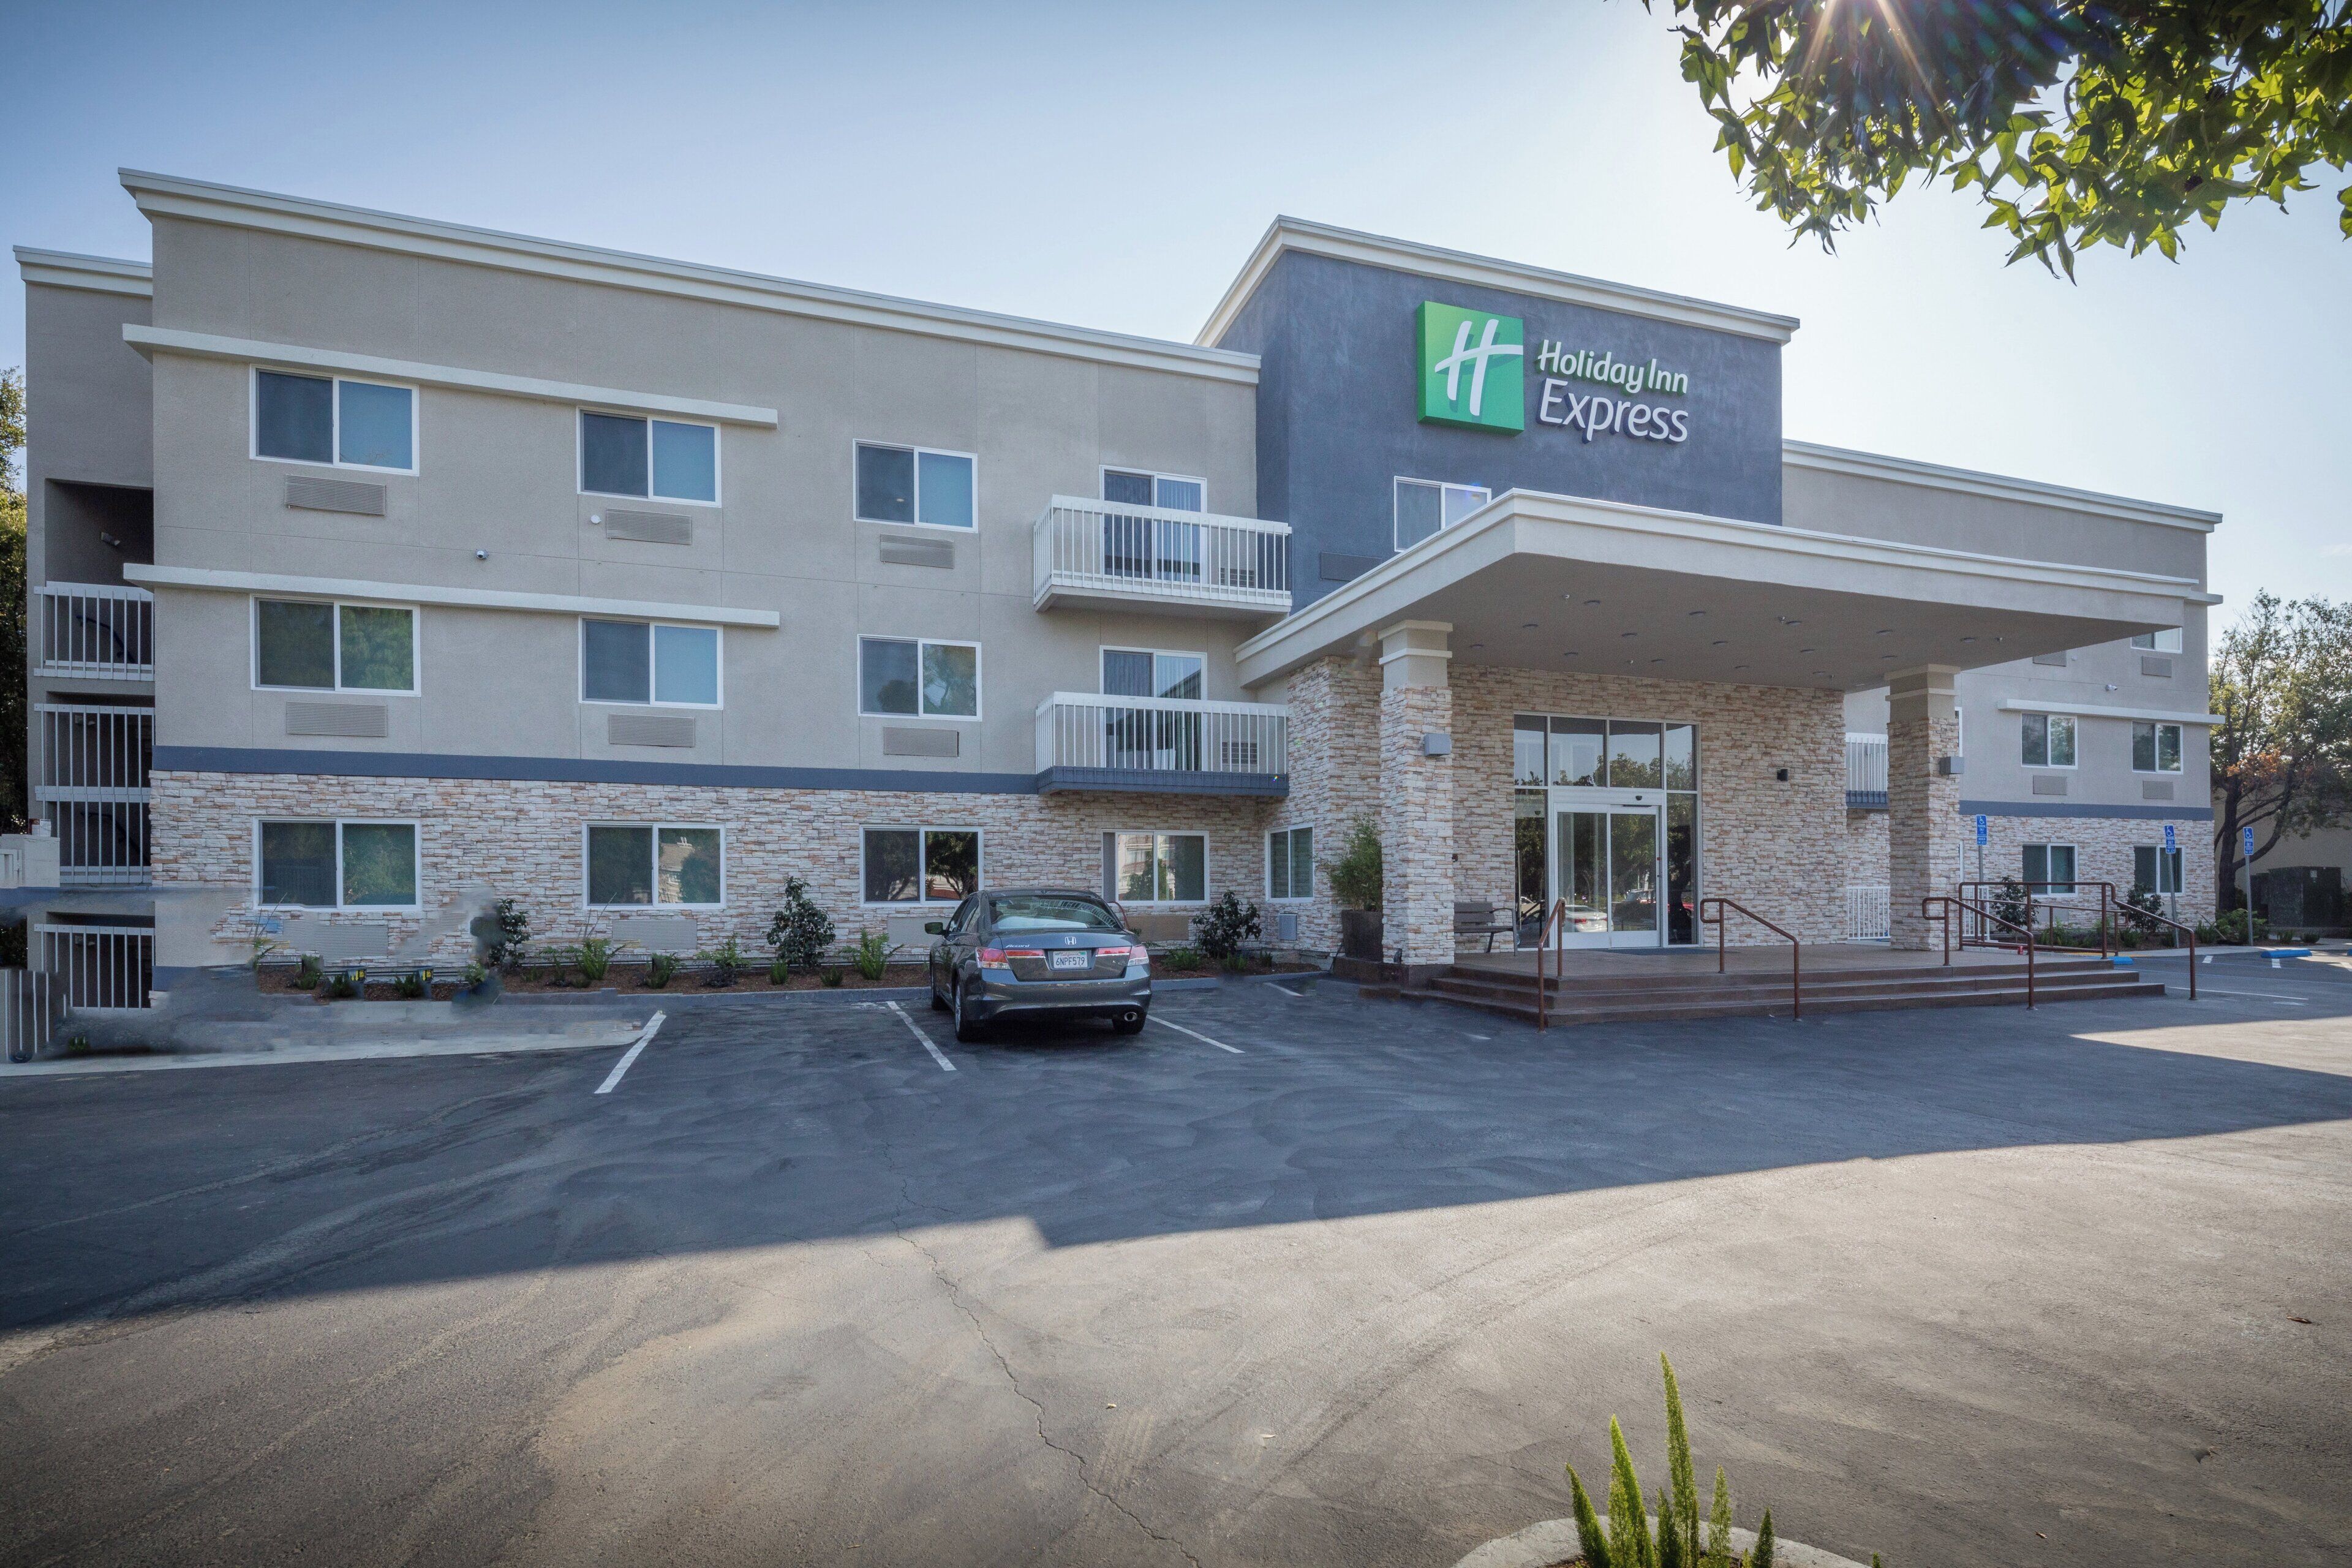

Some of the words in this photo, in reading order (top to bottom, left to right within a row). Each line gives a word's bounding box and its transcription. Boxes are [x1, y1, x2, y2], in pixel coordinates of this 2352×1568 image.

[1537, 339, 1645, 394] Holiday
[1648, 358, 1689, 394] Inn
[1539, 377, 1689, 442] Express
[1056, 957, 1085, 966] 6NPF579
